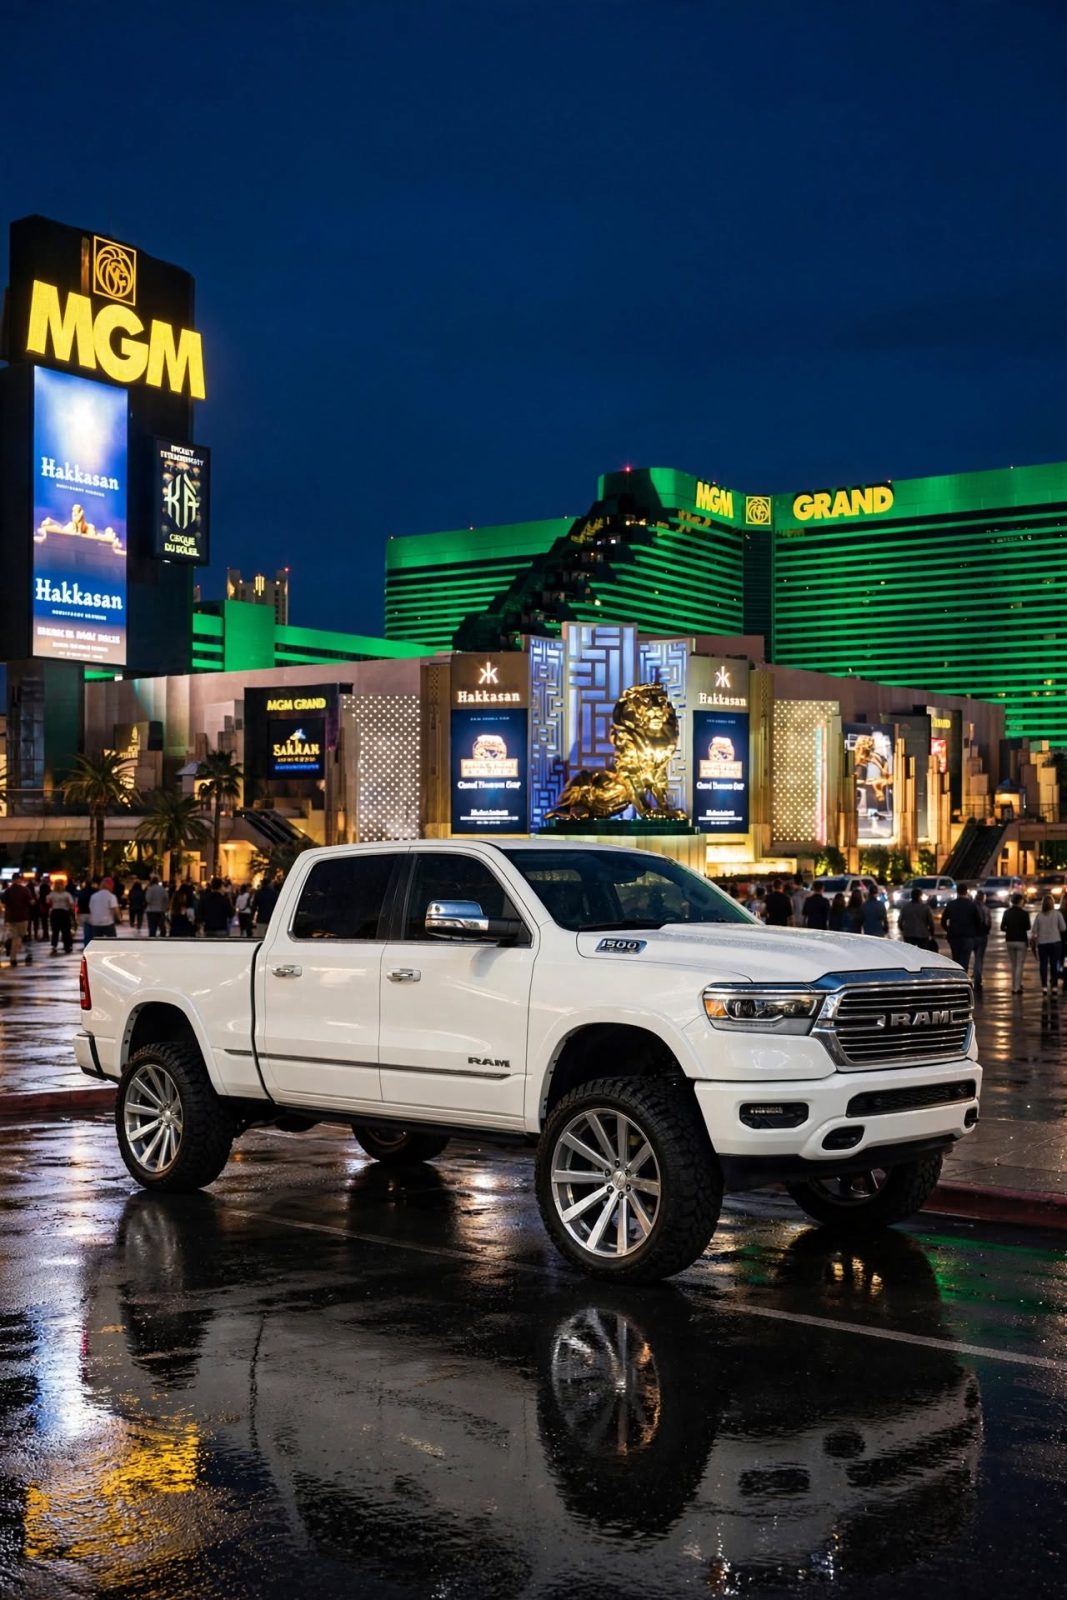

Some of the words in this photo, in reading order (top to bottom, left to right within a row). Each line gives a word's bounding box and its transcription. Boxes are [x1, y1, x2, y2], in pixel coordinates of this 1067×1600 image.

[26, 279, 206, 399] MGM
[41, 456, 119, 490] Hakkasan
[695, 481, 734, 519] MGM
[793, 486, 894, 521] GRAND
[35, 578, 123, 610] Hakkasan
[266, 699, 293, 711] MGM
[293, 697, 327, 710] GRAND
[457, 690, 521, 703] Hakkasan
[699, 692, 747, 706] Hakkasan
[601, 939, 637, 949] 1500
[890, 1010, 949, 1026] RAM
[467, 1056, 511, 1068] RAM
